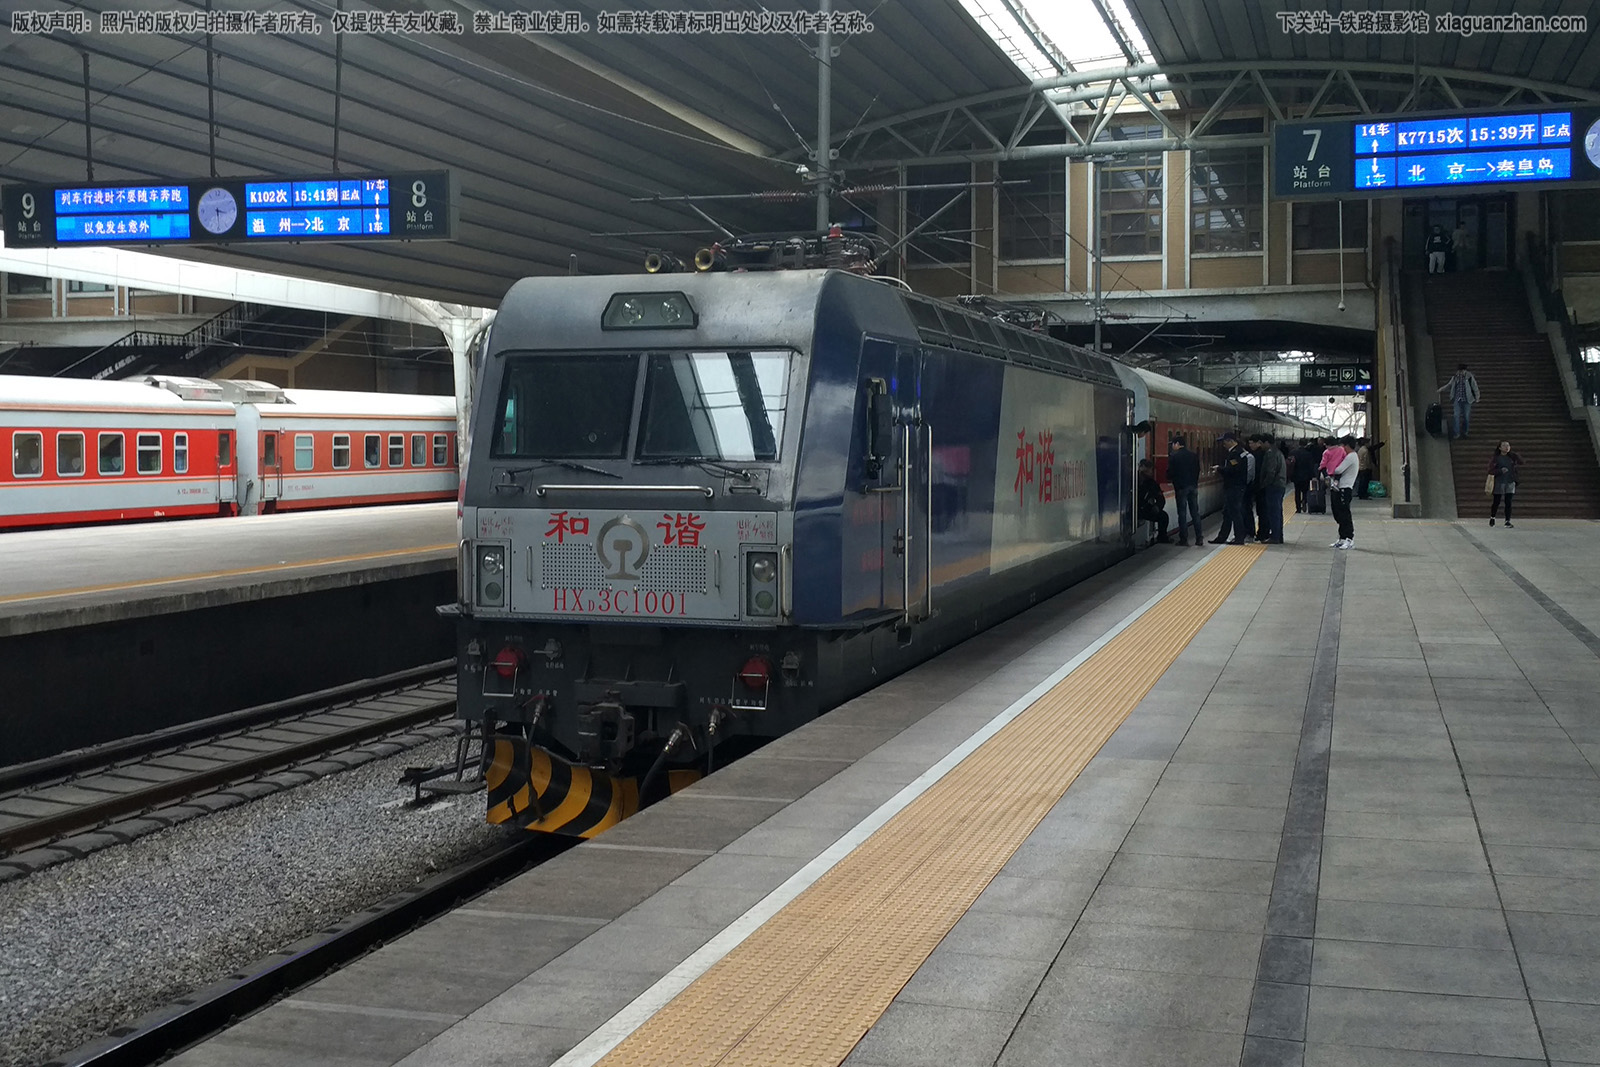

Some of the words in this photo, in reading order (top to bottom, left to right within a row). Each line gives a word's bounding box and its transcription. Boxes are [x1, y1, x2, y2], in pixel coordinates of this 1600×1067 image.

[1362, 123, 1389, 137] 14车
[1398, 127, 1464, 146] K7715次
[1470, 124, 1536, 142] 15:39开
[1542, 124, 1571, 138] 正点
[1303, 129, 1321, 161] 7
[1293, 164, 1331, 179] 站台
[1496, 157, 1554, 178] 秦皇岛
[1293, 180, 1331, 188] Platform
[250, 189, 288, 203] K102次
[294, 188, 338, 202] 15:41到
[341, 189, 360, 201] 正点
[412, 180, 427, 208] 8
[22, 192, 35, 219] 9
[406, 210, 433, 223] 站台
[17, 220, 41, 232] 站台
[84, 219, 150, 235] 以免发生意外
[1304, 368, 1338, 378] 出站口
[1014, 426, 1055, 508] 和谐
[544, 510, 590, 544] 和
[656, 513, 706, 547] 谐
[553, 588, 687, 615] HXD3C1001
